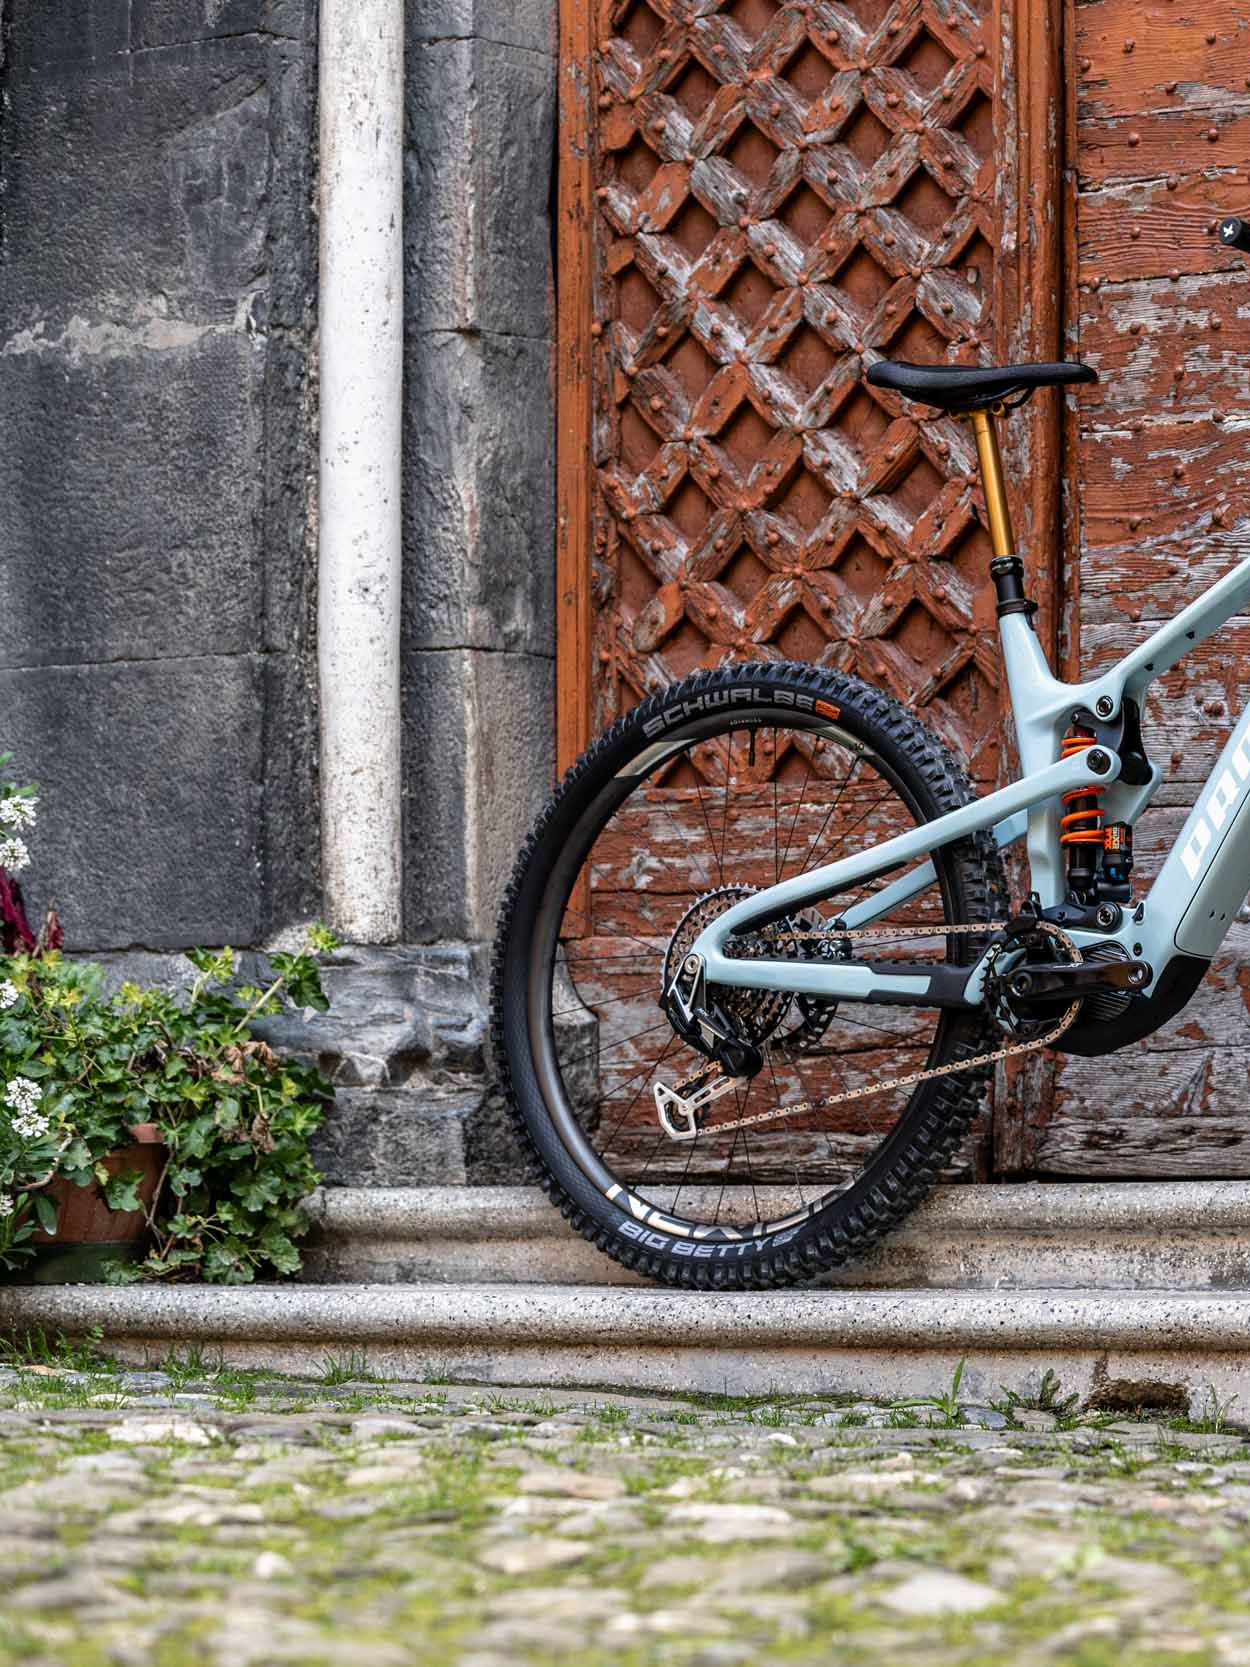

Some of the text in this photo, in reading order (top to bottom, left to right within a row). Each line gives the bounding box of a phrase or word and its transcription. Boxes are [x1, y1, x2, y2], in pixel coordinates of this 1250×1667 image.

[642, 688, 814, 738] SCHWALBE
[618, 1219, 772, 1258] BIG BETTY
